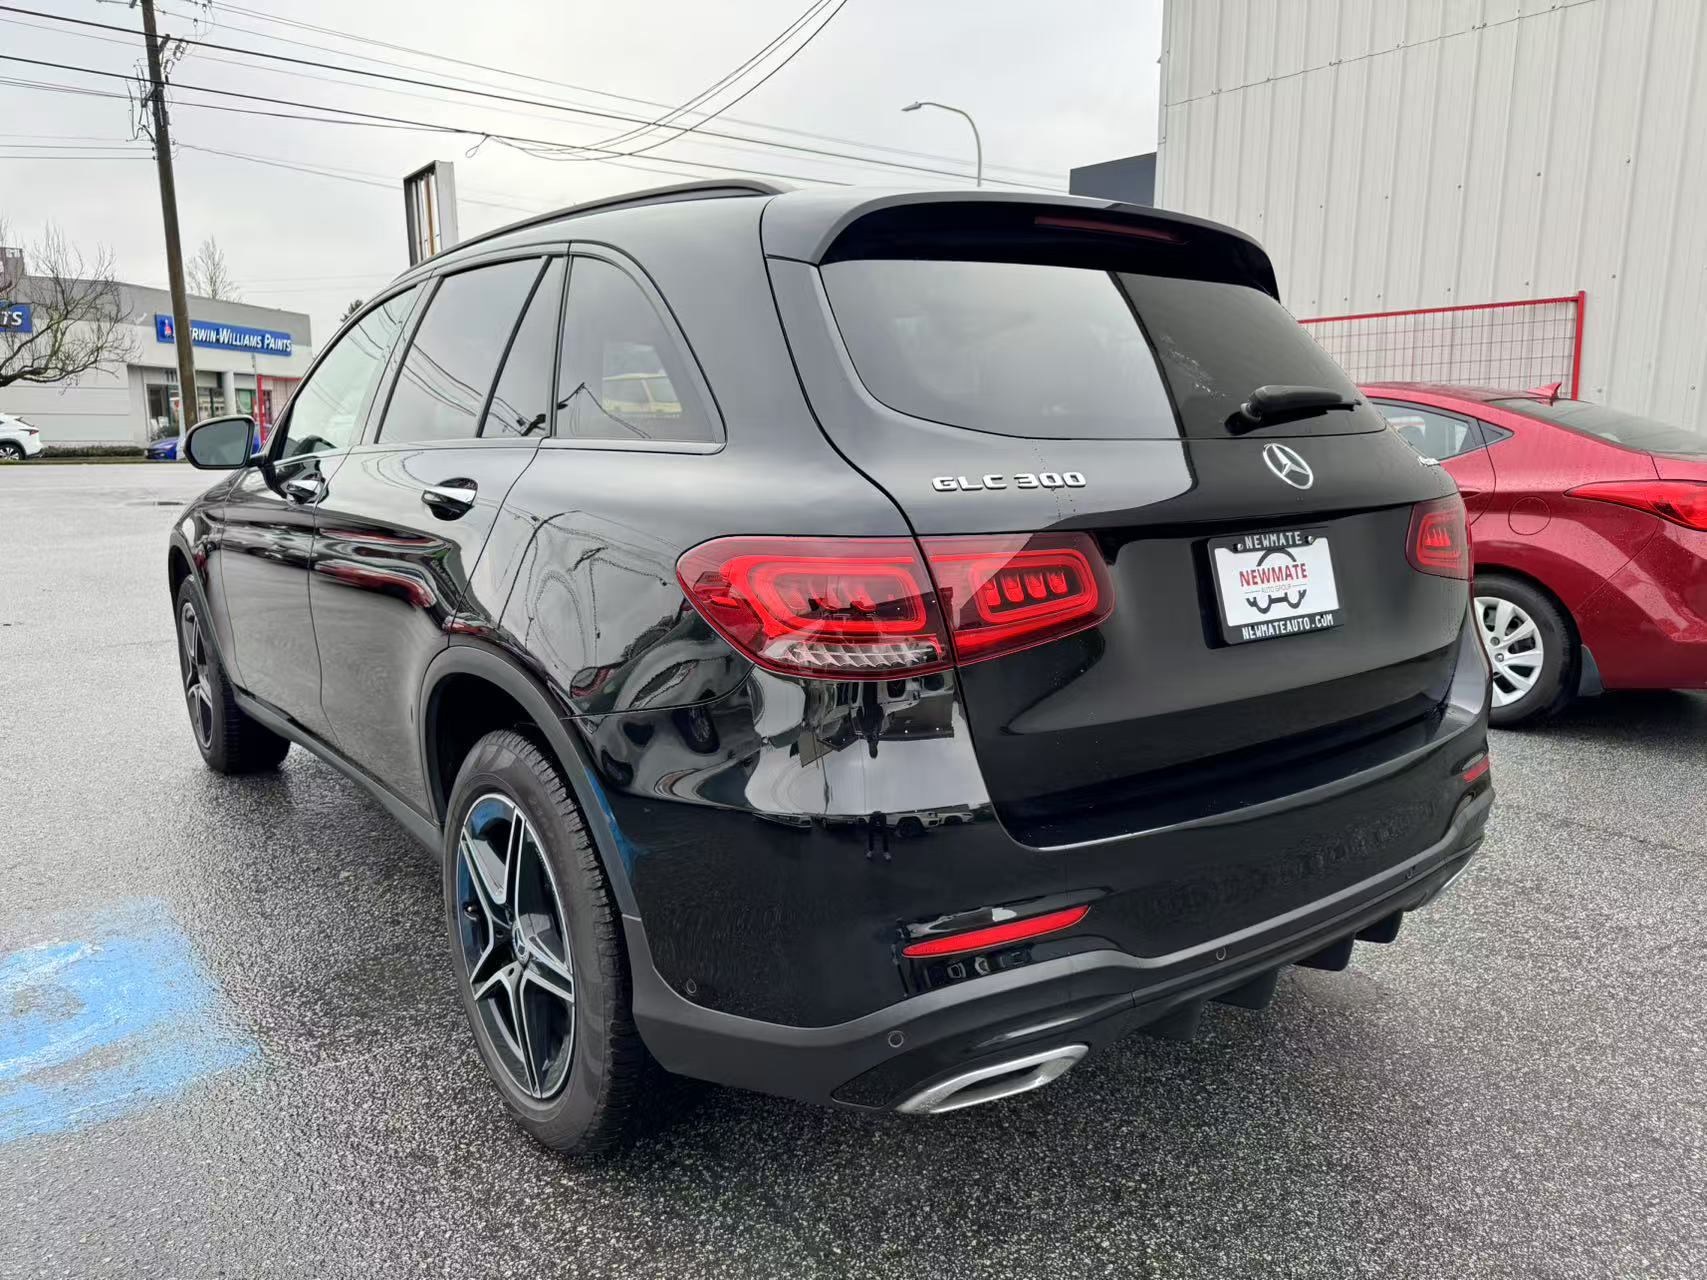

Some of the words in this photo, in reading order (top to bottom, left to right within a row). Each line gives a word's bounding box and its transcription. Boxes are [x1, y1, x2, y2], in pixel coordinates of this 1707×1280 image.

[263, 333, 292, 352] PAINTS
[932, 474, 1007, 491] GLC
[1014, 471, 1087, 489] 300
[1245, 532, 1302, 549] NEWMATE
[1239, 563, 1308, 587] NEWMATE
[1242, 613, 1333, 640] NEWMATEAUTO.COM
